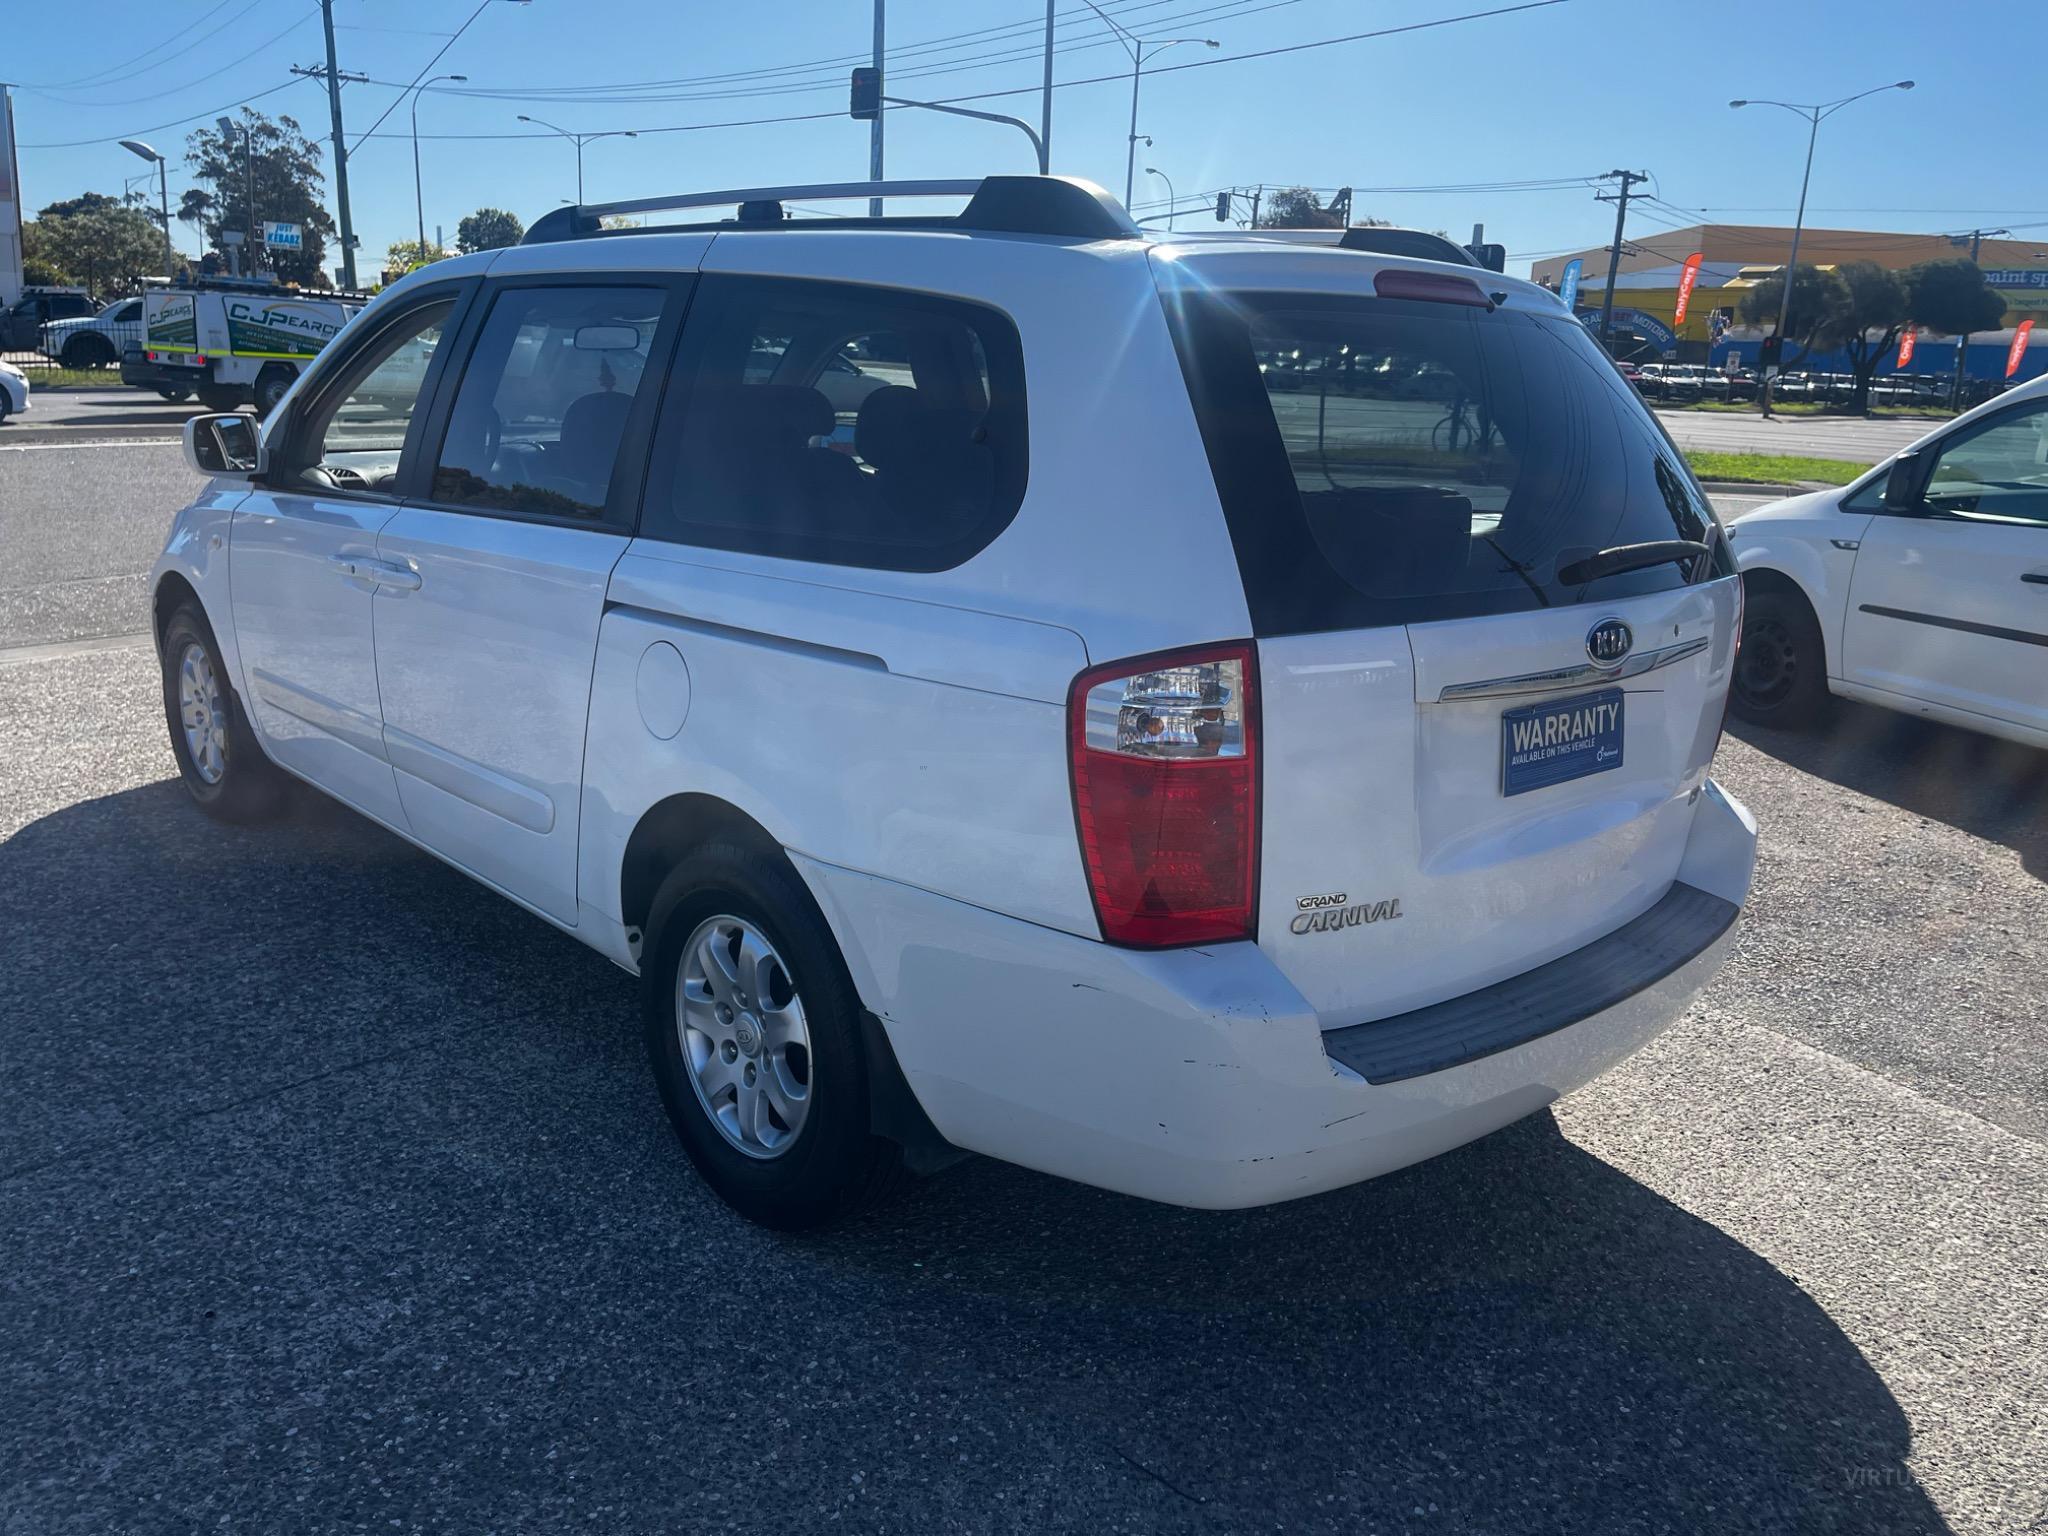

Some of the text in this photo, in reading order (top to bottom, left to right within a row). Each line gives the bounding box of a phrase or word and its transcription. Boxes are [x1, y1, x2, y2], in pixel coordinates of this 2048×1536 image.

[1632, 314, 1670, 343] MOTORS
[1596, 629, 1628, 656] KIA
[1512, 702, 1619, 753] WARRANTY
[1511, 737, 1596, 766] AVAILABLE ON THIS VEHICLE
[1299, 893, 1347, 909] GRAND
[1290, 899, 1403, 936] CARNIVAL
